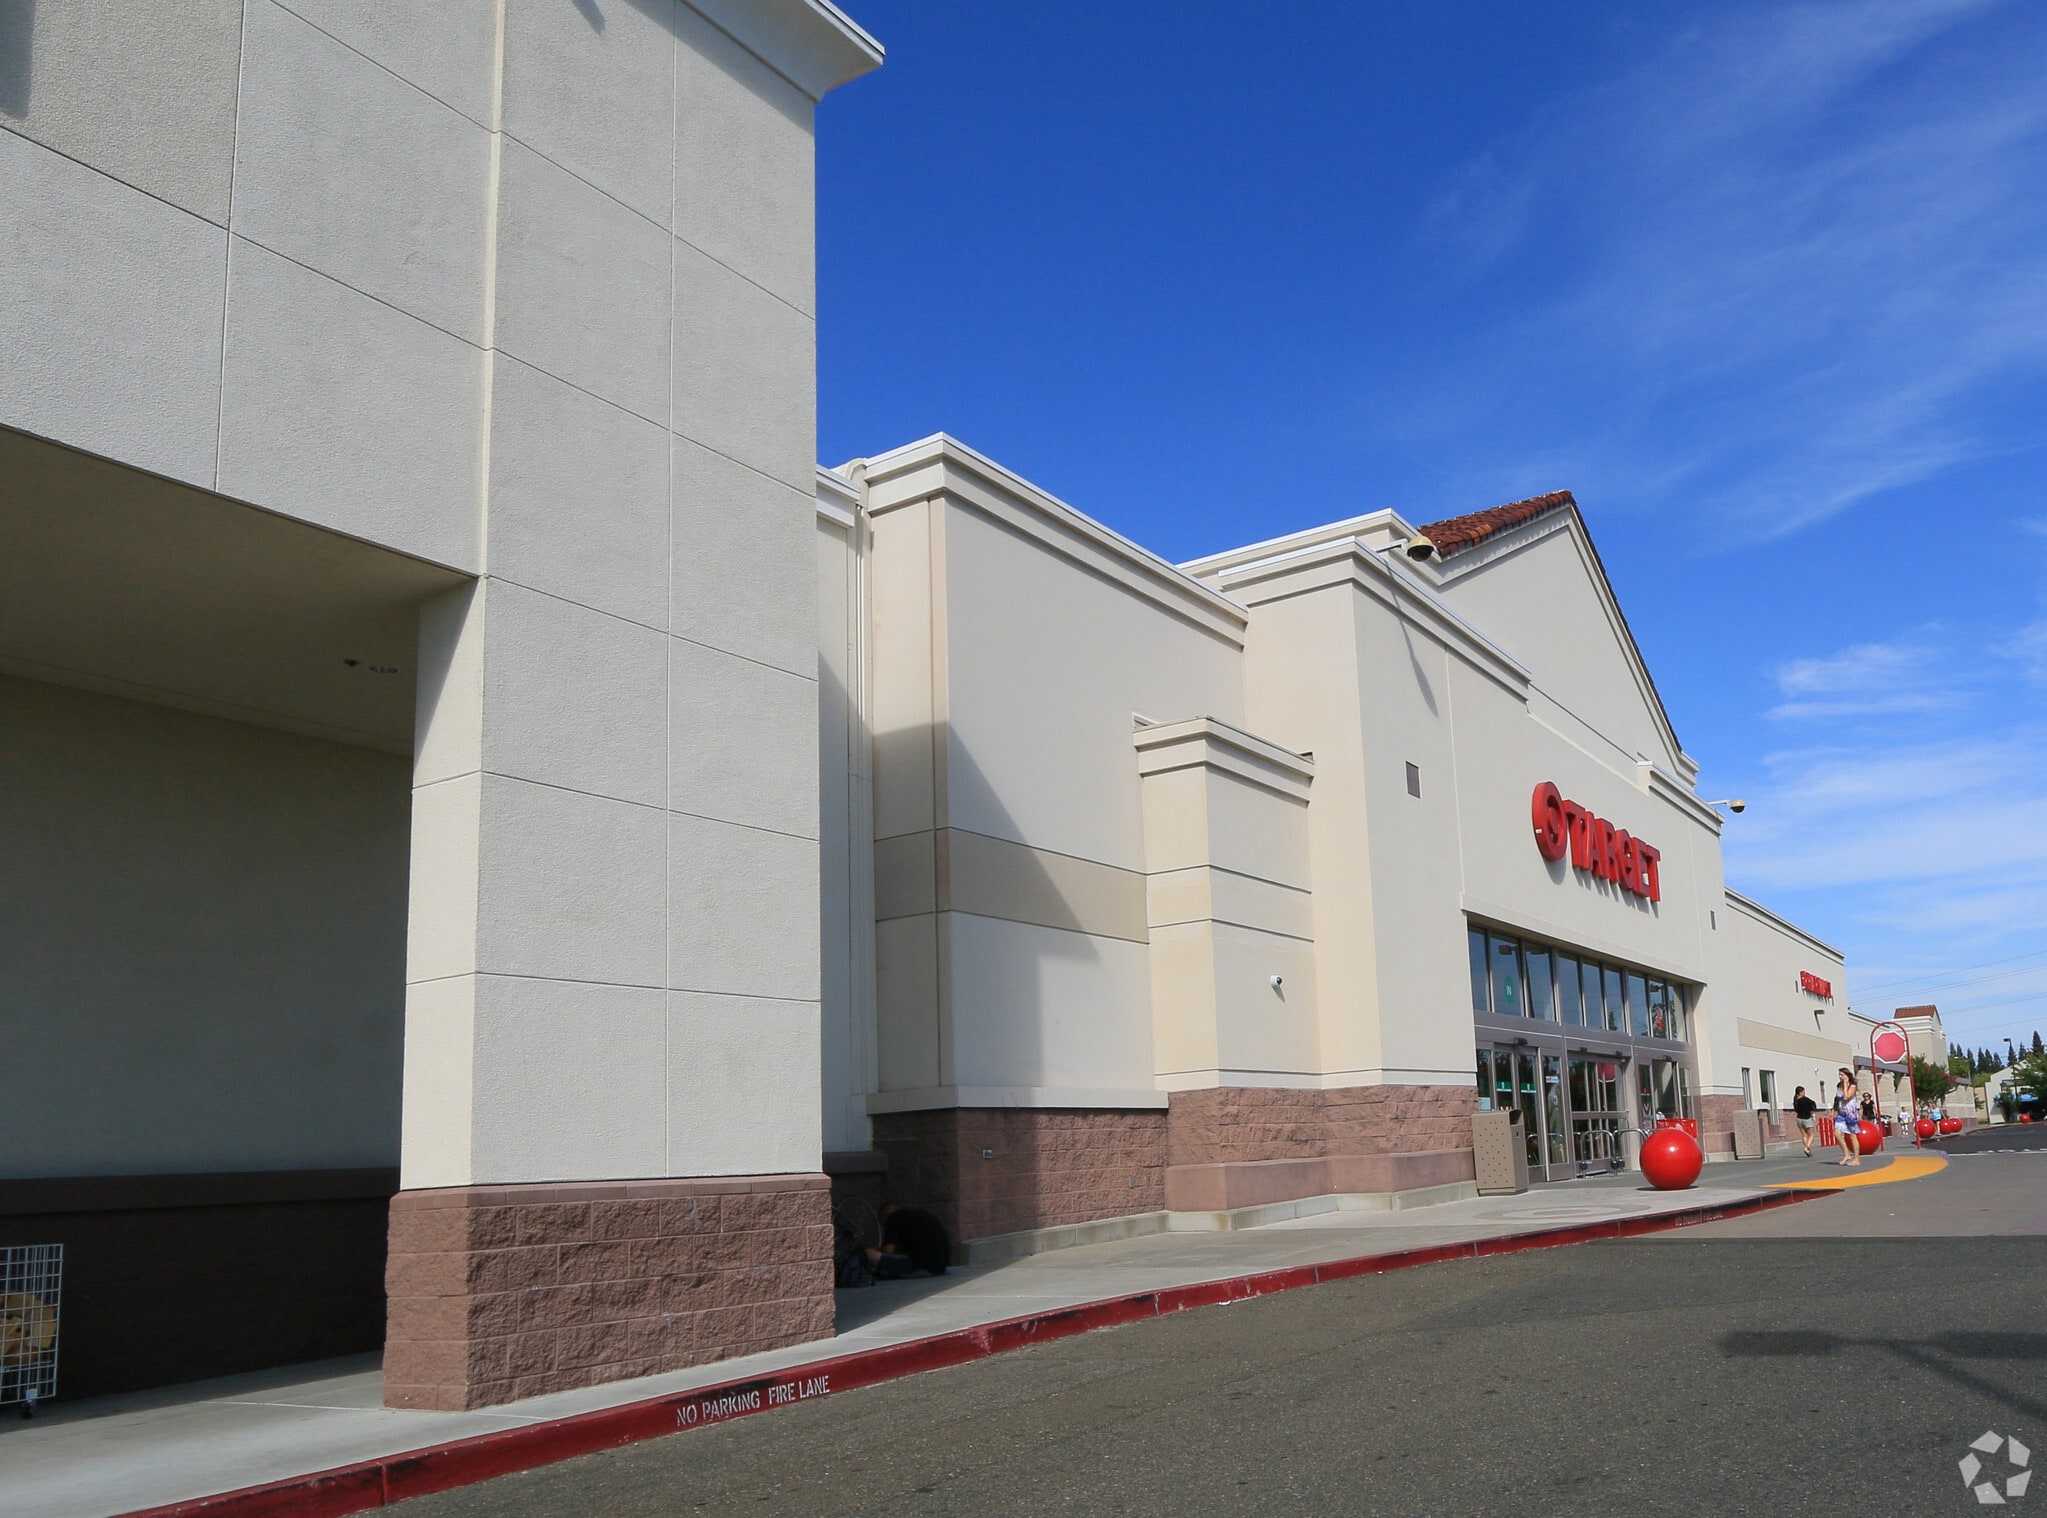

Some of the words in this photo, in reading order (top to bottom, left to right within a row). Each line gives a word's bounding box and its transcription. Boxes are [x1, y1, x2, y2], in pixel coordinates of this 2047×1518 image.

[1562, 799, 1661, 902] TARGET
[676, 1404, 698, 1427] NO
[702, 1390, 760, 1420] PARKING
[768, 1382, 795, 1406] FIRE
[798, 1375, 830, 1399] LANE
